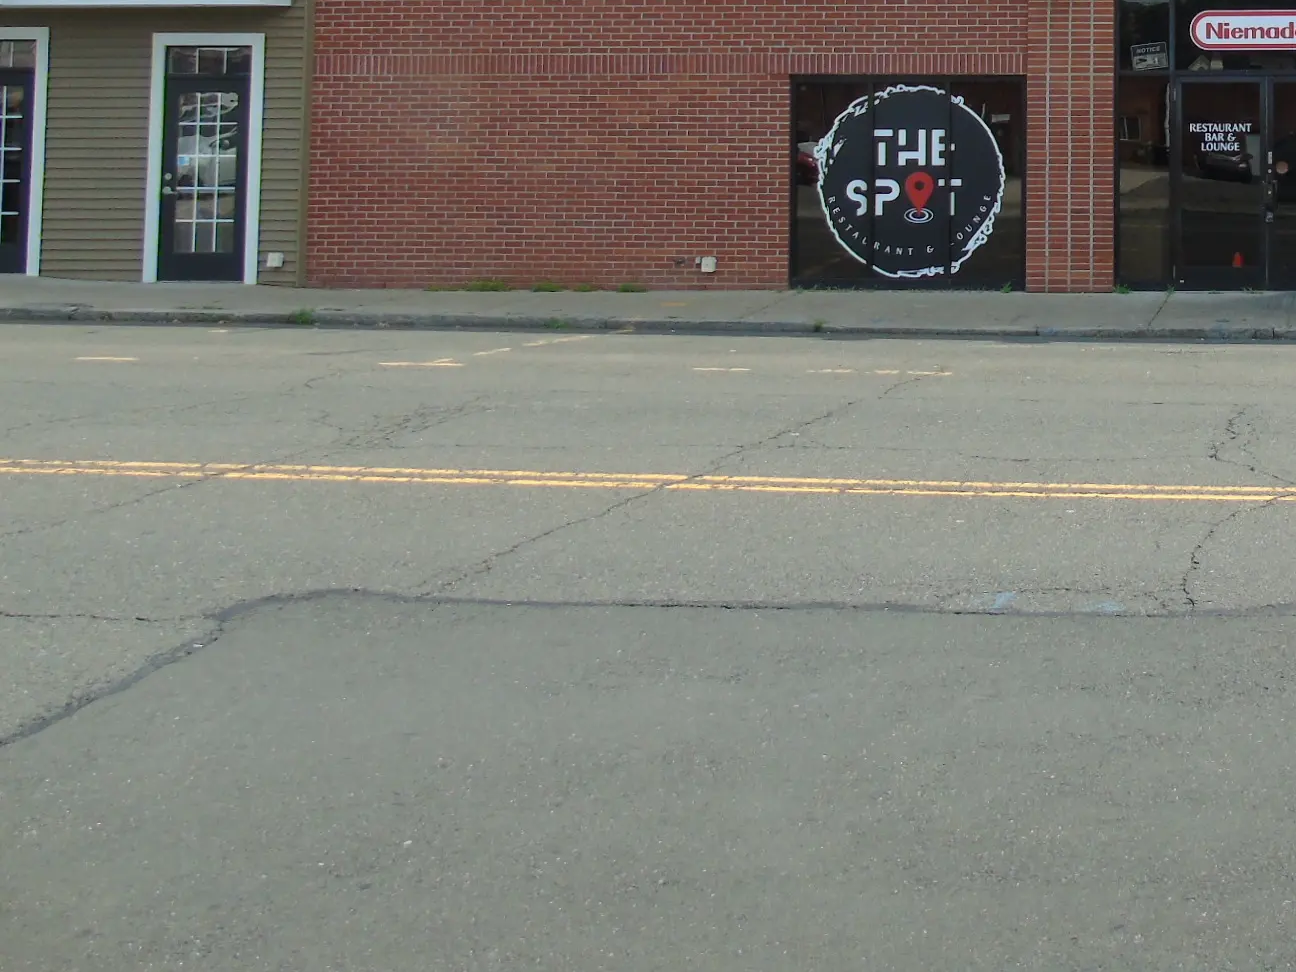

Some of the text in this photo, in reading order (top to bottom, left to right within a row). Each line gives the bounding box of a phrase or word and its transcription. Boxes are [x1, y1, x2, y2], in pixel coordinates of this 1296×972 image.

[1136, 45, 1160, 54] NOTICE
[1189, 122, 1252, 133] RESTAURANT
[1204, 132, 1237, 142] BAR &
[873, 129, 956, 166] THE
[1200, 142, 1240, 152] LOUNGE
[926, 245, 934, 254] &
[950, 194, 992, 246] OUNGE
